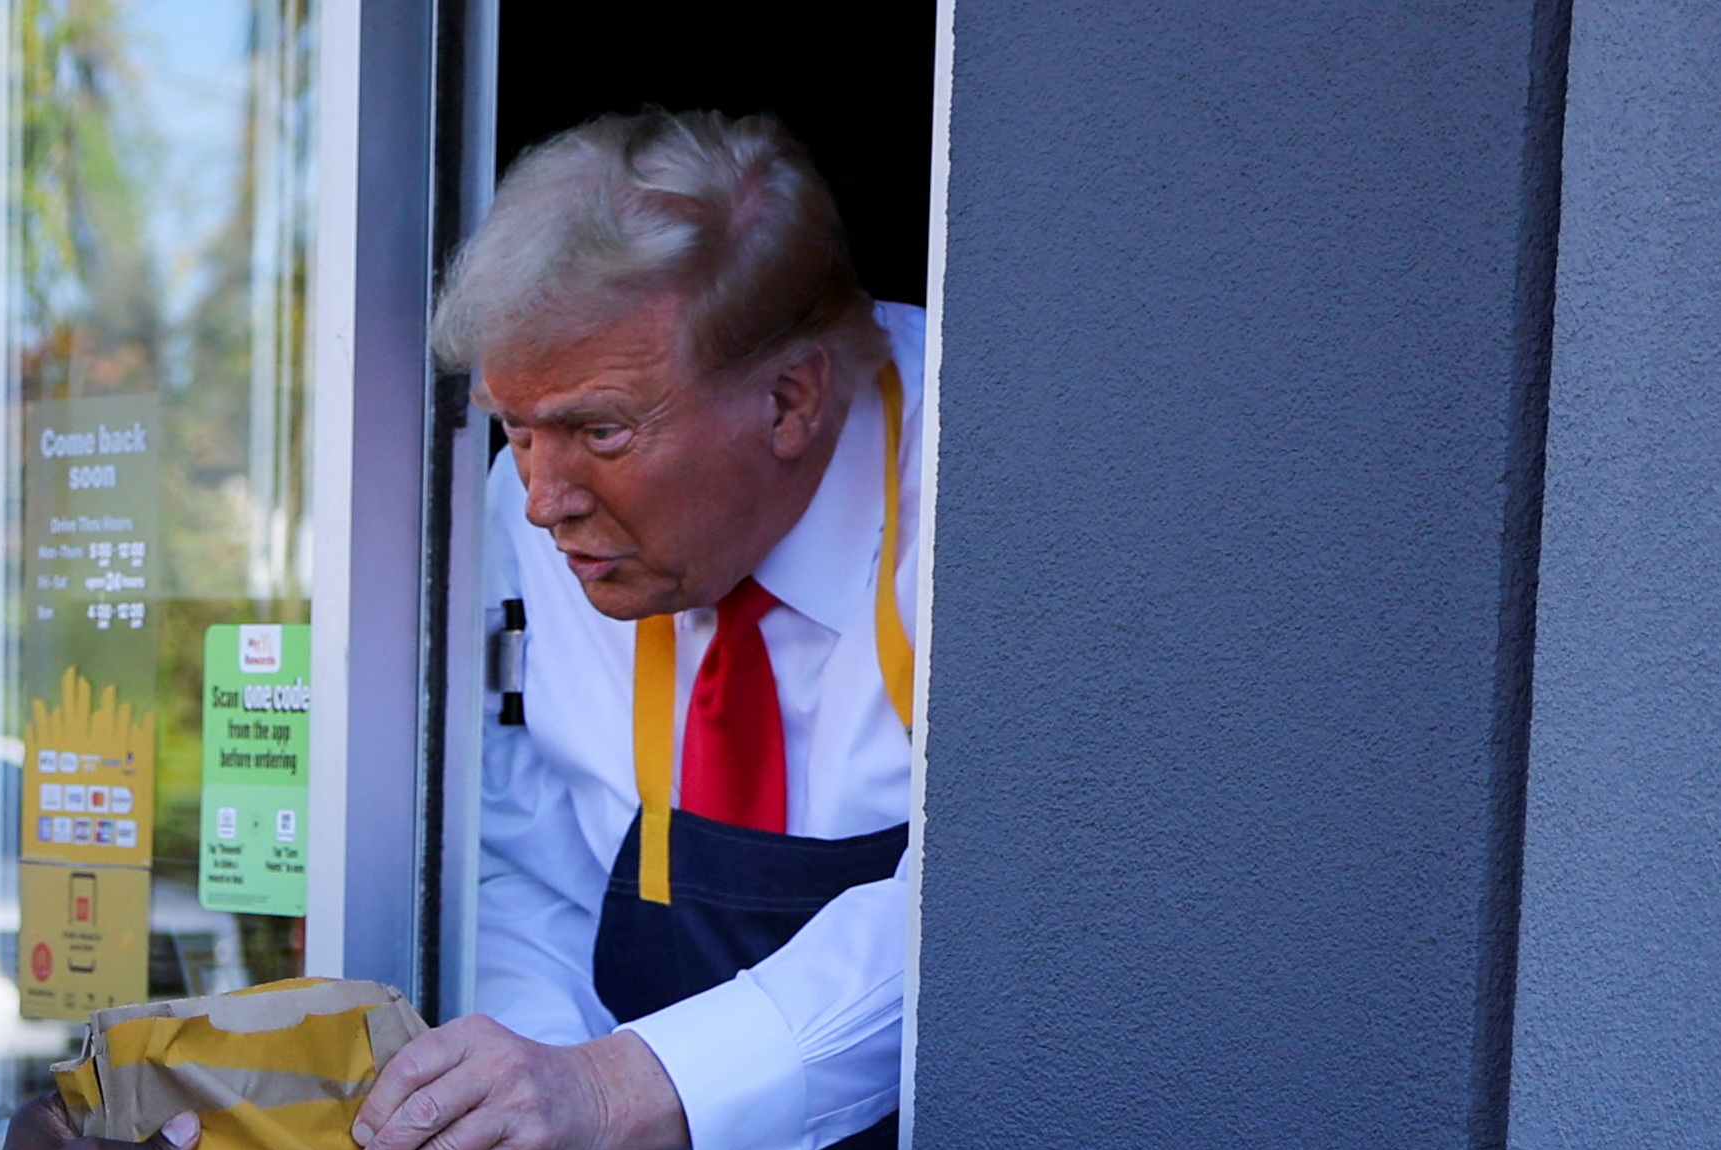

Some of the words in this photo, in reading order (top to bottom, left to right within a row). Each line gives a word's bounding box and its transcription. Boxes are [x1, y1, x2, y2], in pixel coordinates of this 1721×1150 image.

[40, 427, 95, 458] Come
[97, 422, 147, 454] back
[69, 464, 116, 490] soon
[212, 685, 238, 708] Scan
[244, 685, 272, 711] one
[273, 677, 310, 712] code
[228, 718, 250, 739] from
[252, 719, 269, 740] the
[273, 724, 291, 746] app
[220, 748, 251, 768] before
[255, 750, 297, 776] ordering
